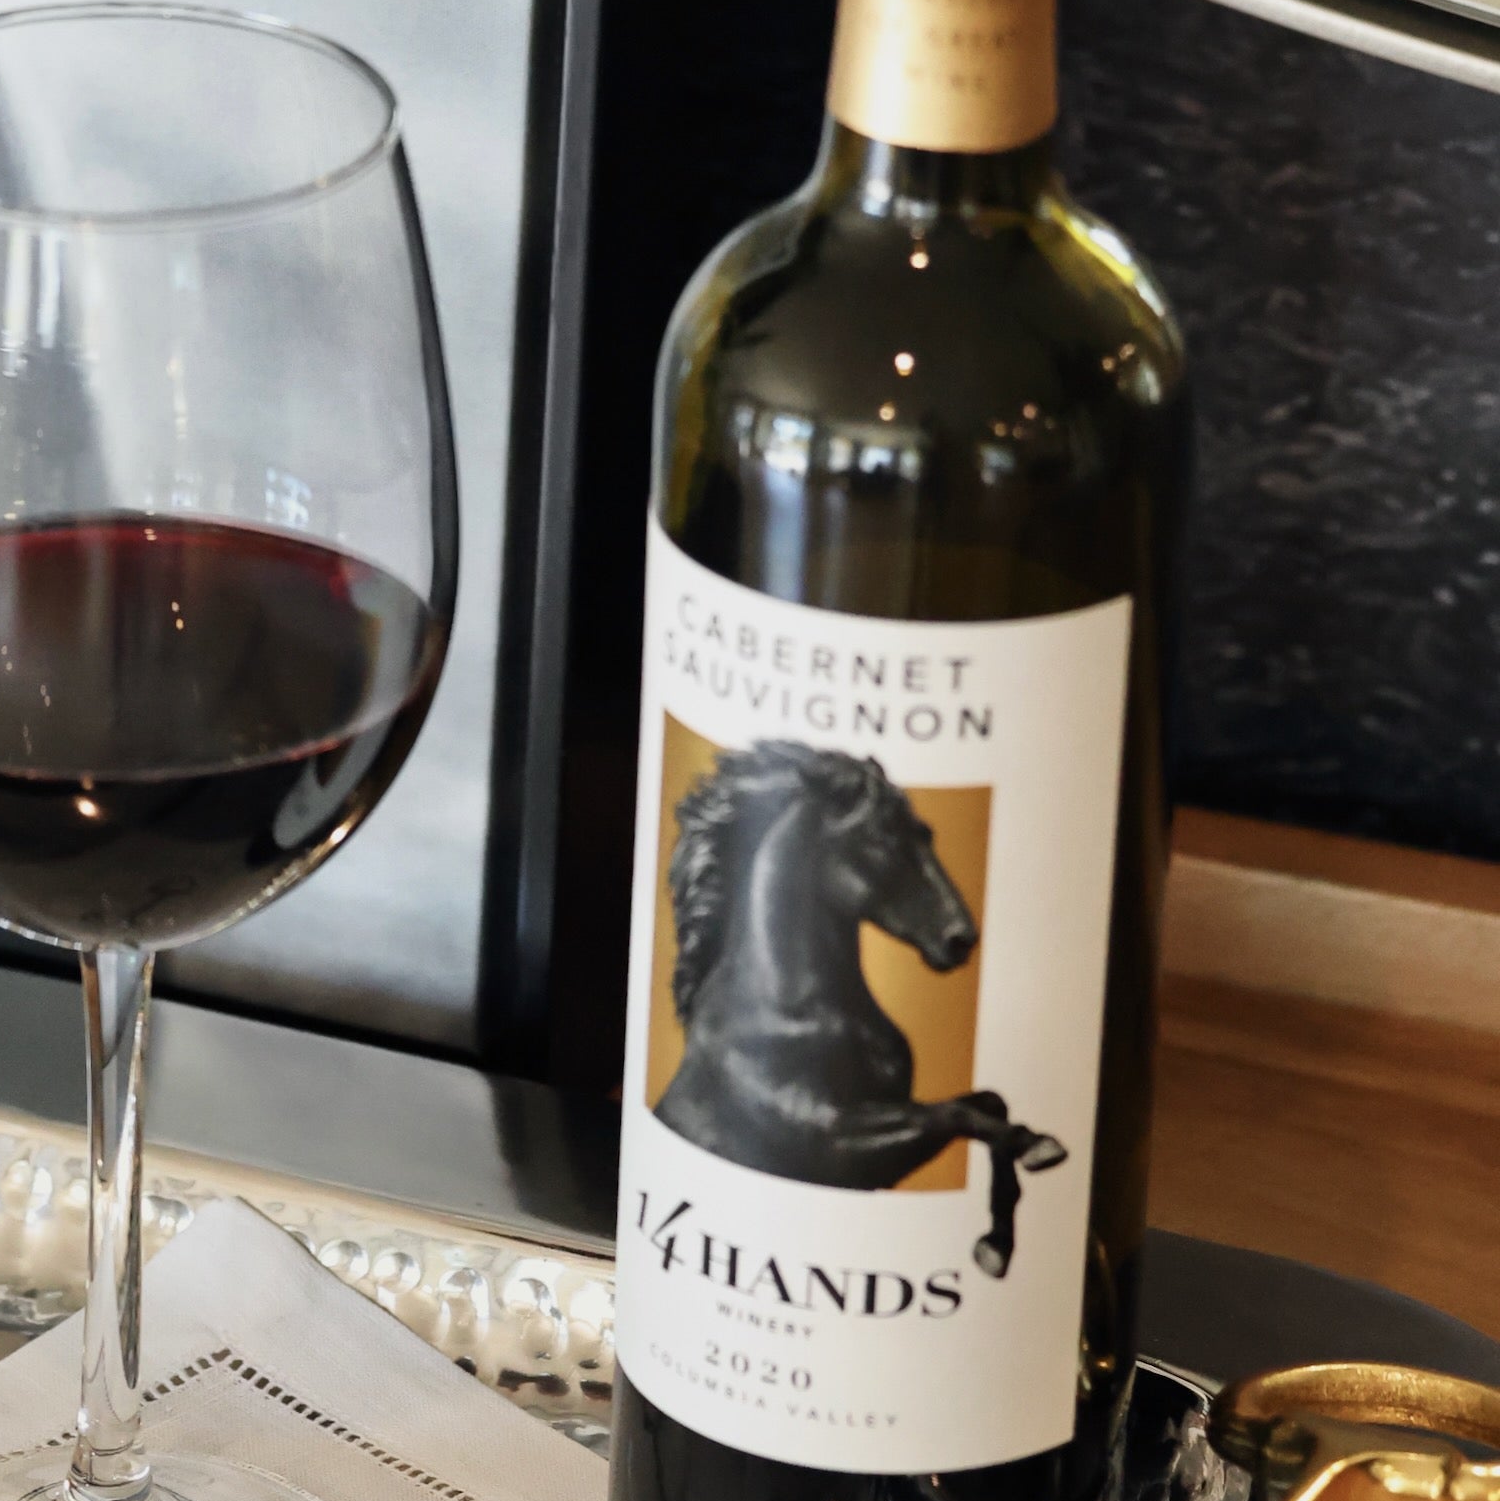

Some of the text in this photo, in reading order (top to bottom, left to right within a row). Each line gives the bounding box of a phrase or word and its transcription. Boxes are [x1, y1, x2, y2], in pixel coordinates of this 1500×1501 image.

[665, 631, 994, 740] SAUVIGNON
[677, 595, 972, 691] CABERNET
[698, 1231, 964, 1319] HANDS
[716, 1300, 814, 1339] WINERY
[650, 1342, 899, 1428] COLUMBIA VALLEY
[704, 1340, 813, 1392] 2020
